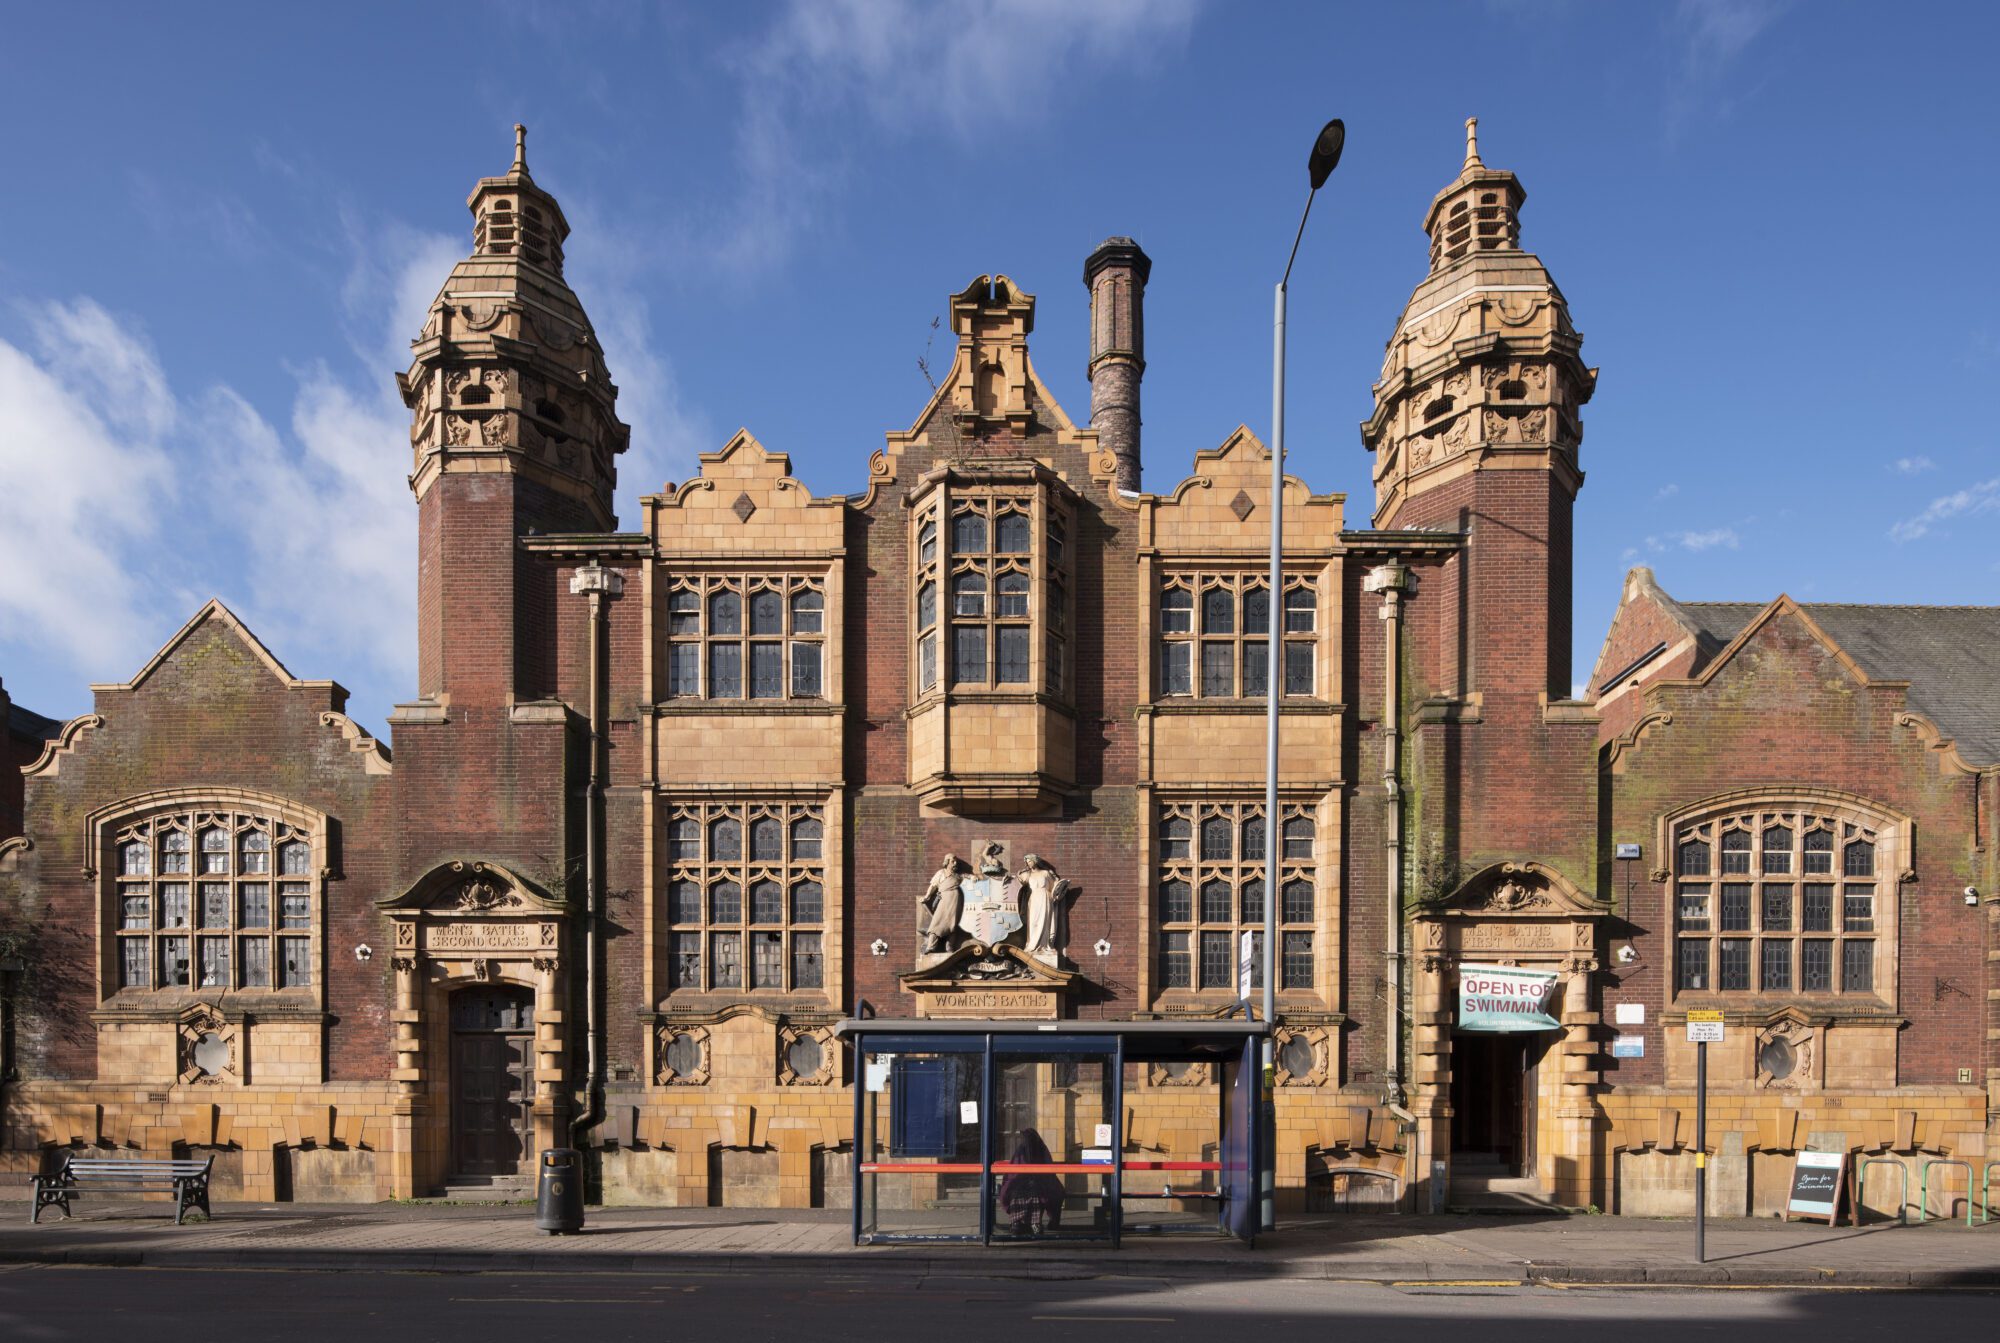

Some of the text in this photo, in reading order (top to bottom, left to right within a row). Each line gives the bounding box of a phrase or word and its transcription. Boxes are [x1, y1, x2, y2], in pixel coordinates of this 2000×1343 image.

[436, 925, 525, 936] MEN'S BATHS
[1465, 926, 1551, 936] MEN'S BATHS
[432, 936, 529, 947] SECOND CLASS
[1463, 938, 1555, 948] FIRST CLASS
[1466, 980, 1514, 996] OPEN
[935, 994, 1047, 1007] WOMEN'S BATHS
[1960, 1069, 1970, 1081] H
[1801, 1173, 1832, 1184] Open for
[1796, 1182, 1835, 1191] Swimming
